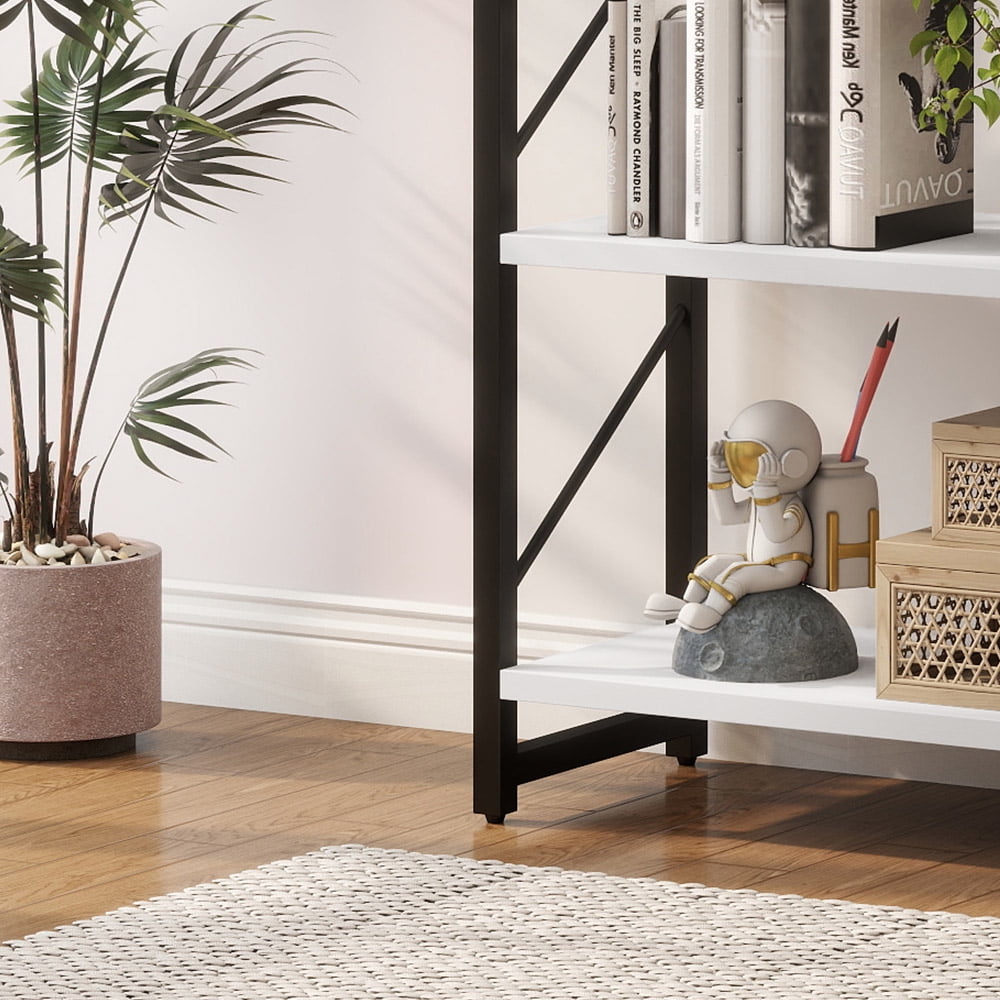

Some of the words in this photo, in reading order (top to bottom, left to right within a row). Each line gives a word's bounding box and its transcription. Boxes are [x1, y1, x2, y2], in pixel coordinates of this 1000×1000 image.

[633, 4, 642, 23] THE
[694, 1, 705, 37] LOOKING
[633, 26, 642, 45] BIG
[694, 38, 705, 53] FOR
[633, 49, 642, 77] SLEEP
[694, 54, 705, 110] TRANSMISSION
[633, 91, 642, 145] RAYMOND
[633, 148, 642, 203] CHANDLER
